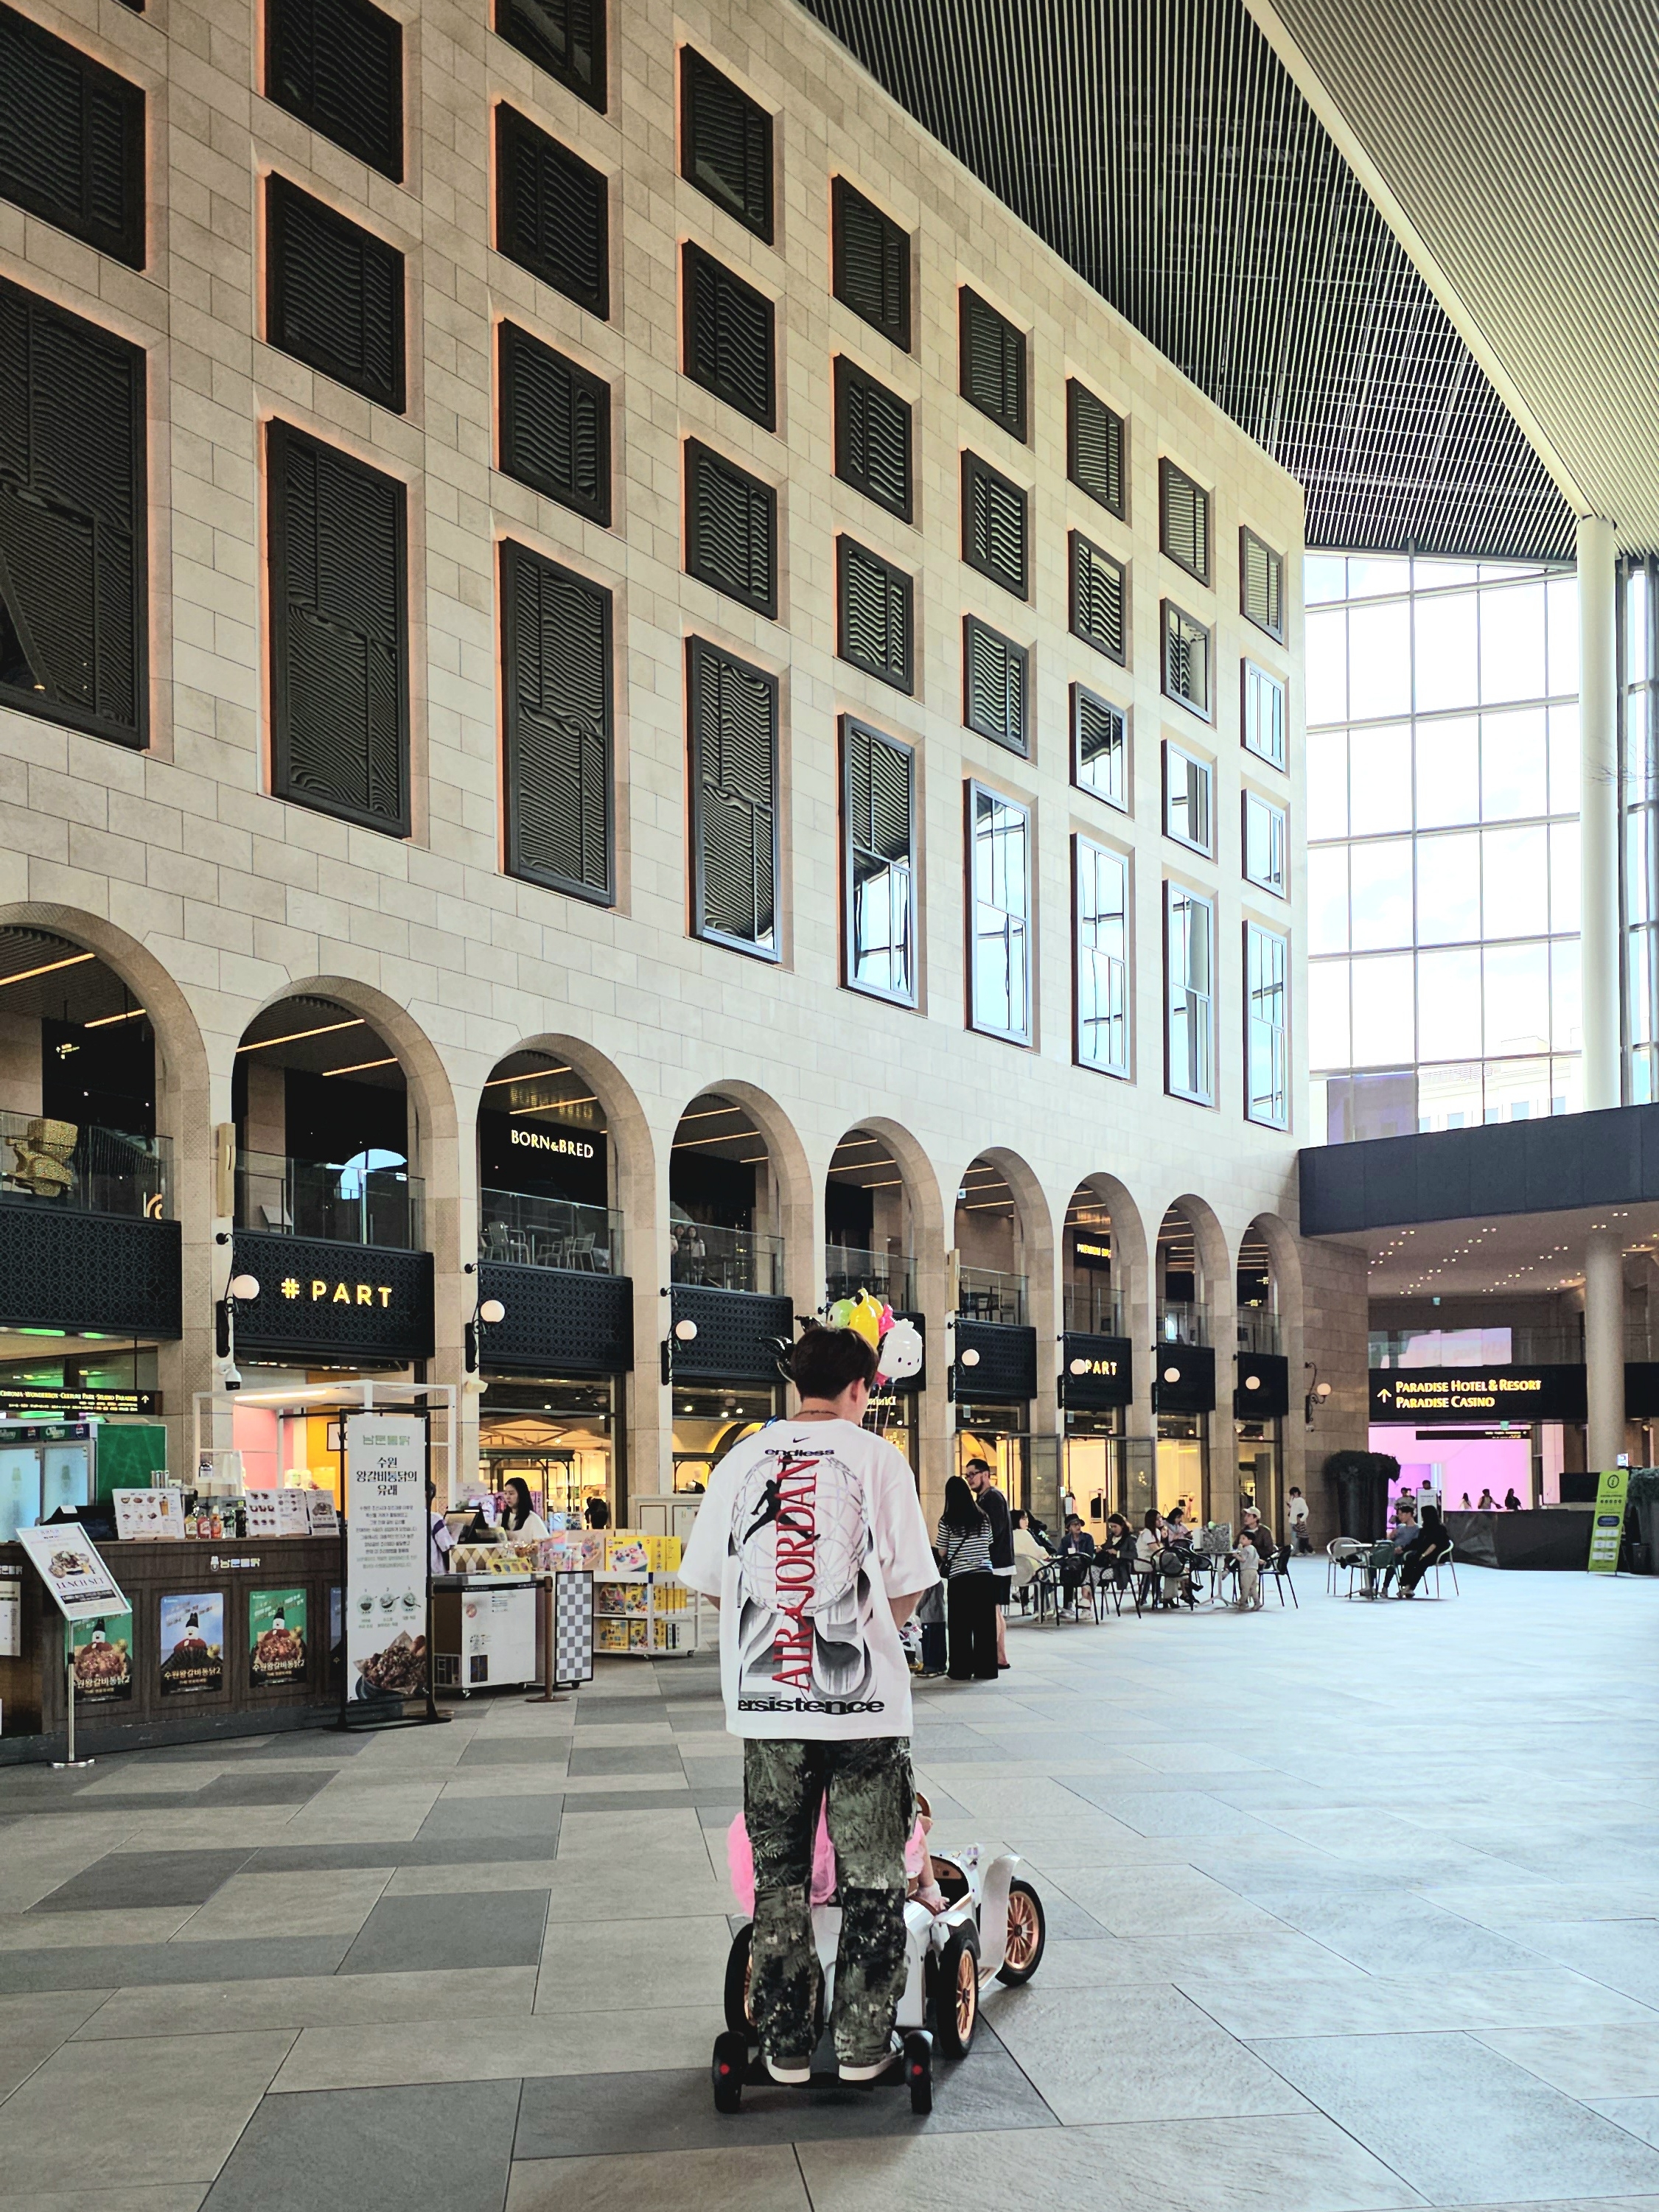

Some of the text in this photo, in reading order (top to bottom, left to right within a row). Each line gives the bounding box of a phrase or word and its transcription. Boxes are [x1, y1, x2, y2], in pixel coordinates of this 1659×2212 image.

[511, 1130, 594, 1158] BORN&BRED
[1396, 1379, 1542, 1393] PARADISE HOTEL & RESORT
[1396, 1396, 1495, 1409] PARADISE CASINO
[764, 1449, 835, 1457] endless
[377, 1457, 397, 1469] 수원
[356, 1471, 417, 1483] 왕갈비통닭의
[377, 1484, 398, 1497] 유래
[775, 1455, 820, 1599] JORDAN
[772, 1625, 812, 1693] AIR
[74, 1674, 130, 1689] 원왕갈비통닭2
